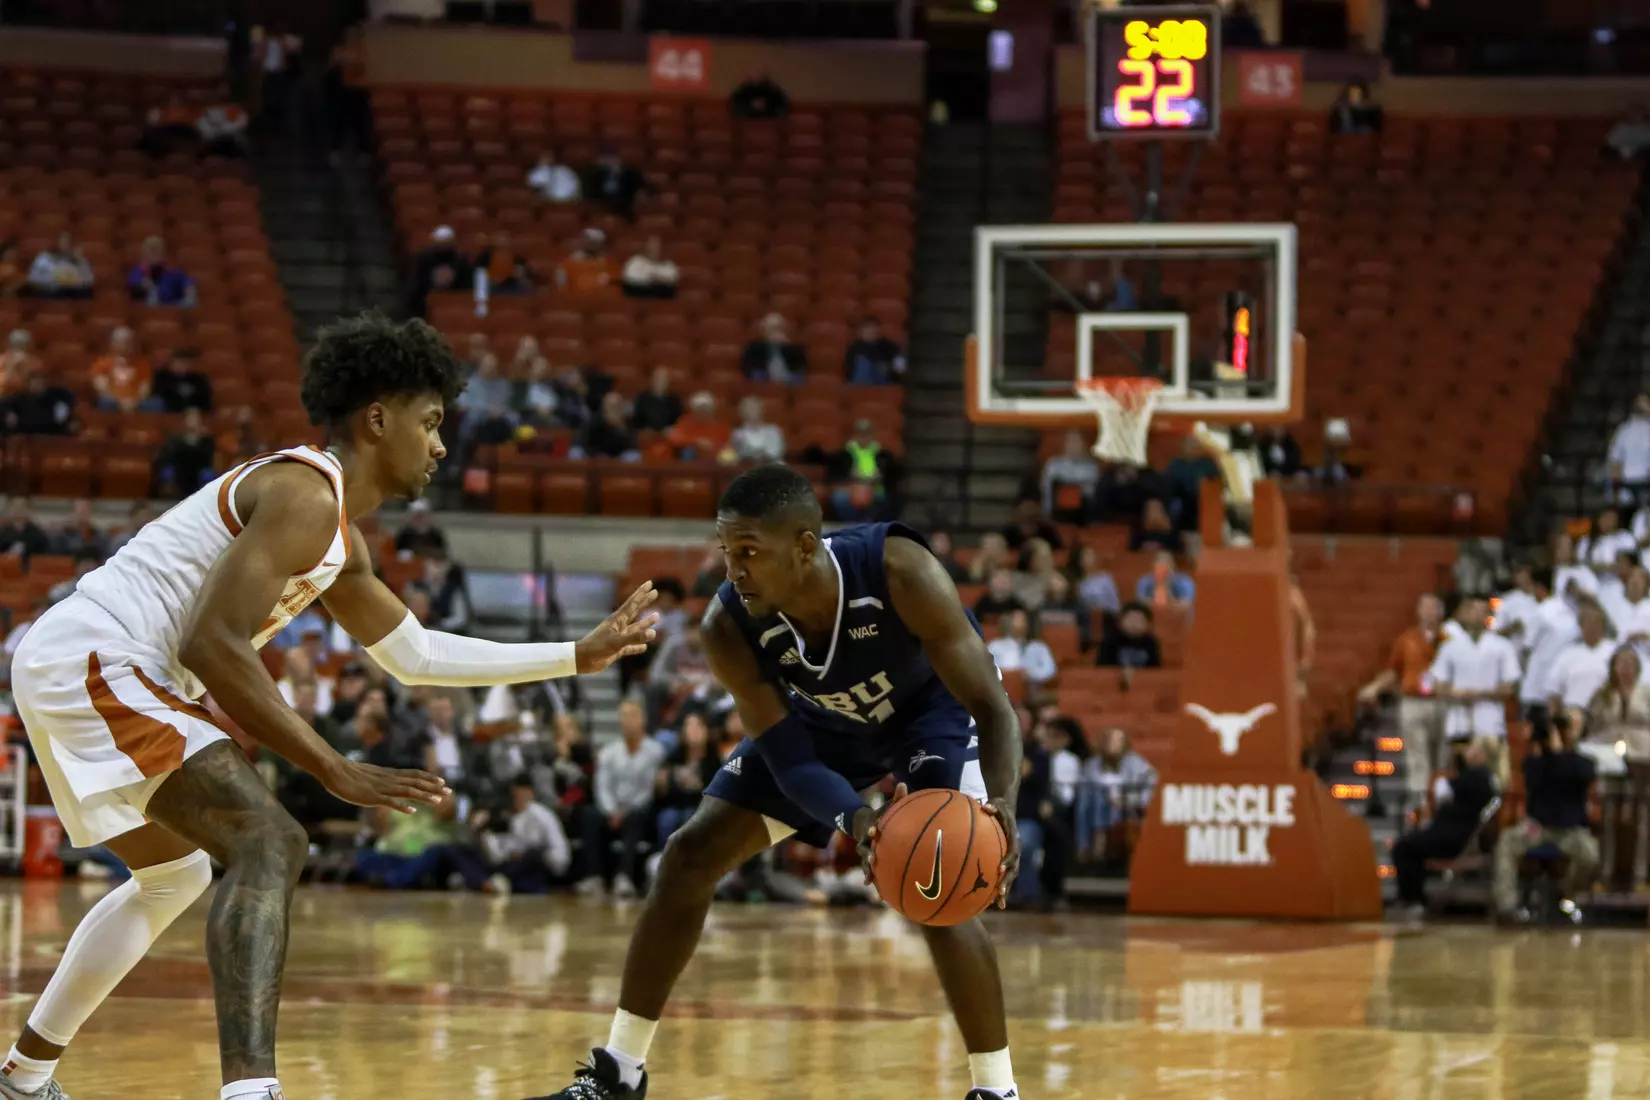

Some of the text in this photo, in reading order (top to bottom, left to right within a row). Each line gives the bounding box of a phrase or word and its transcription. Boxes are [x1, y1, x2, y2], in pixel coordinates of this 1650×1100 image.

[656, 48, 702, 82] 44
[1248, 64, 1295, 98] 43
[1114, 59, 1194, 127] 22
[848, 623, 879, 640] WAC
[789, 671, 894, 711] BU
[1162, 784, 1296, 826] MUSCLE
[1186, 825, 1271, 866] MILK
